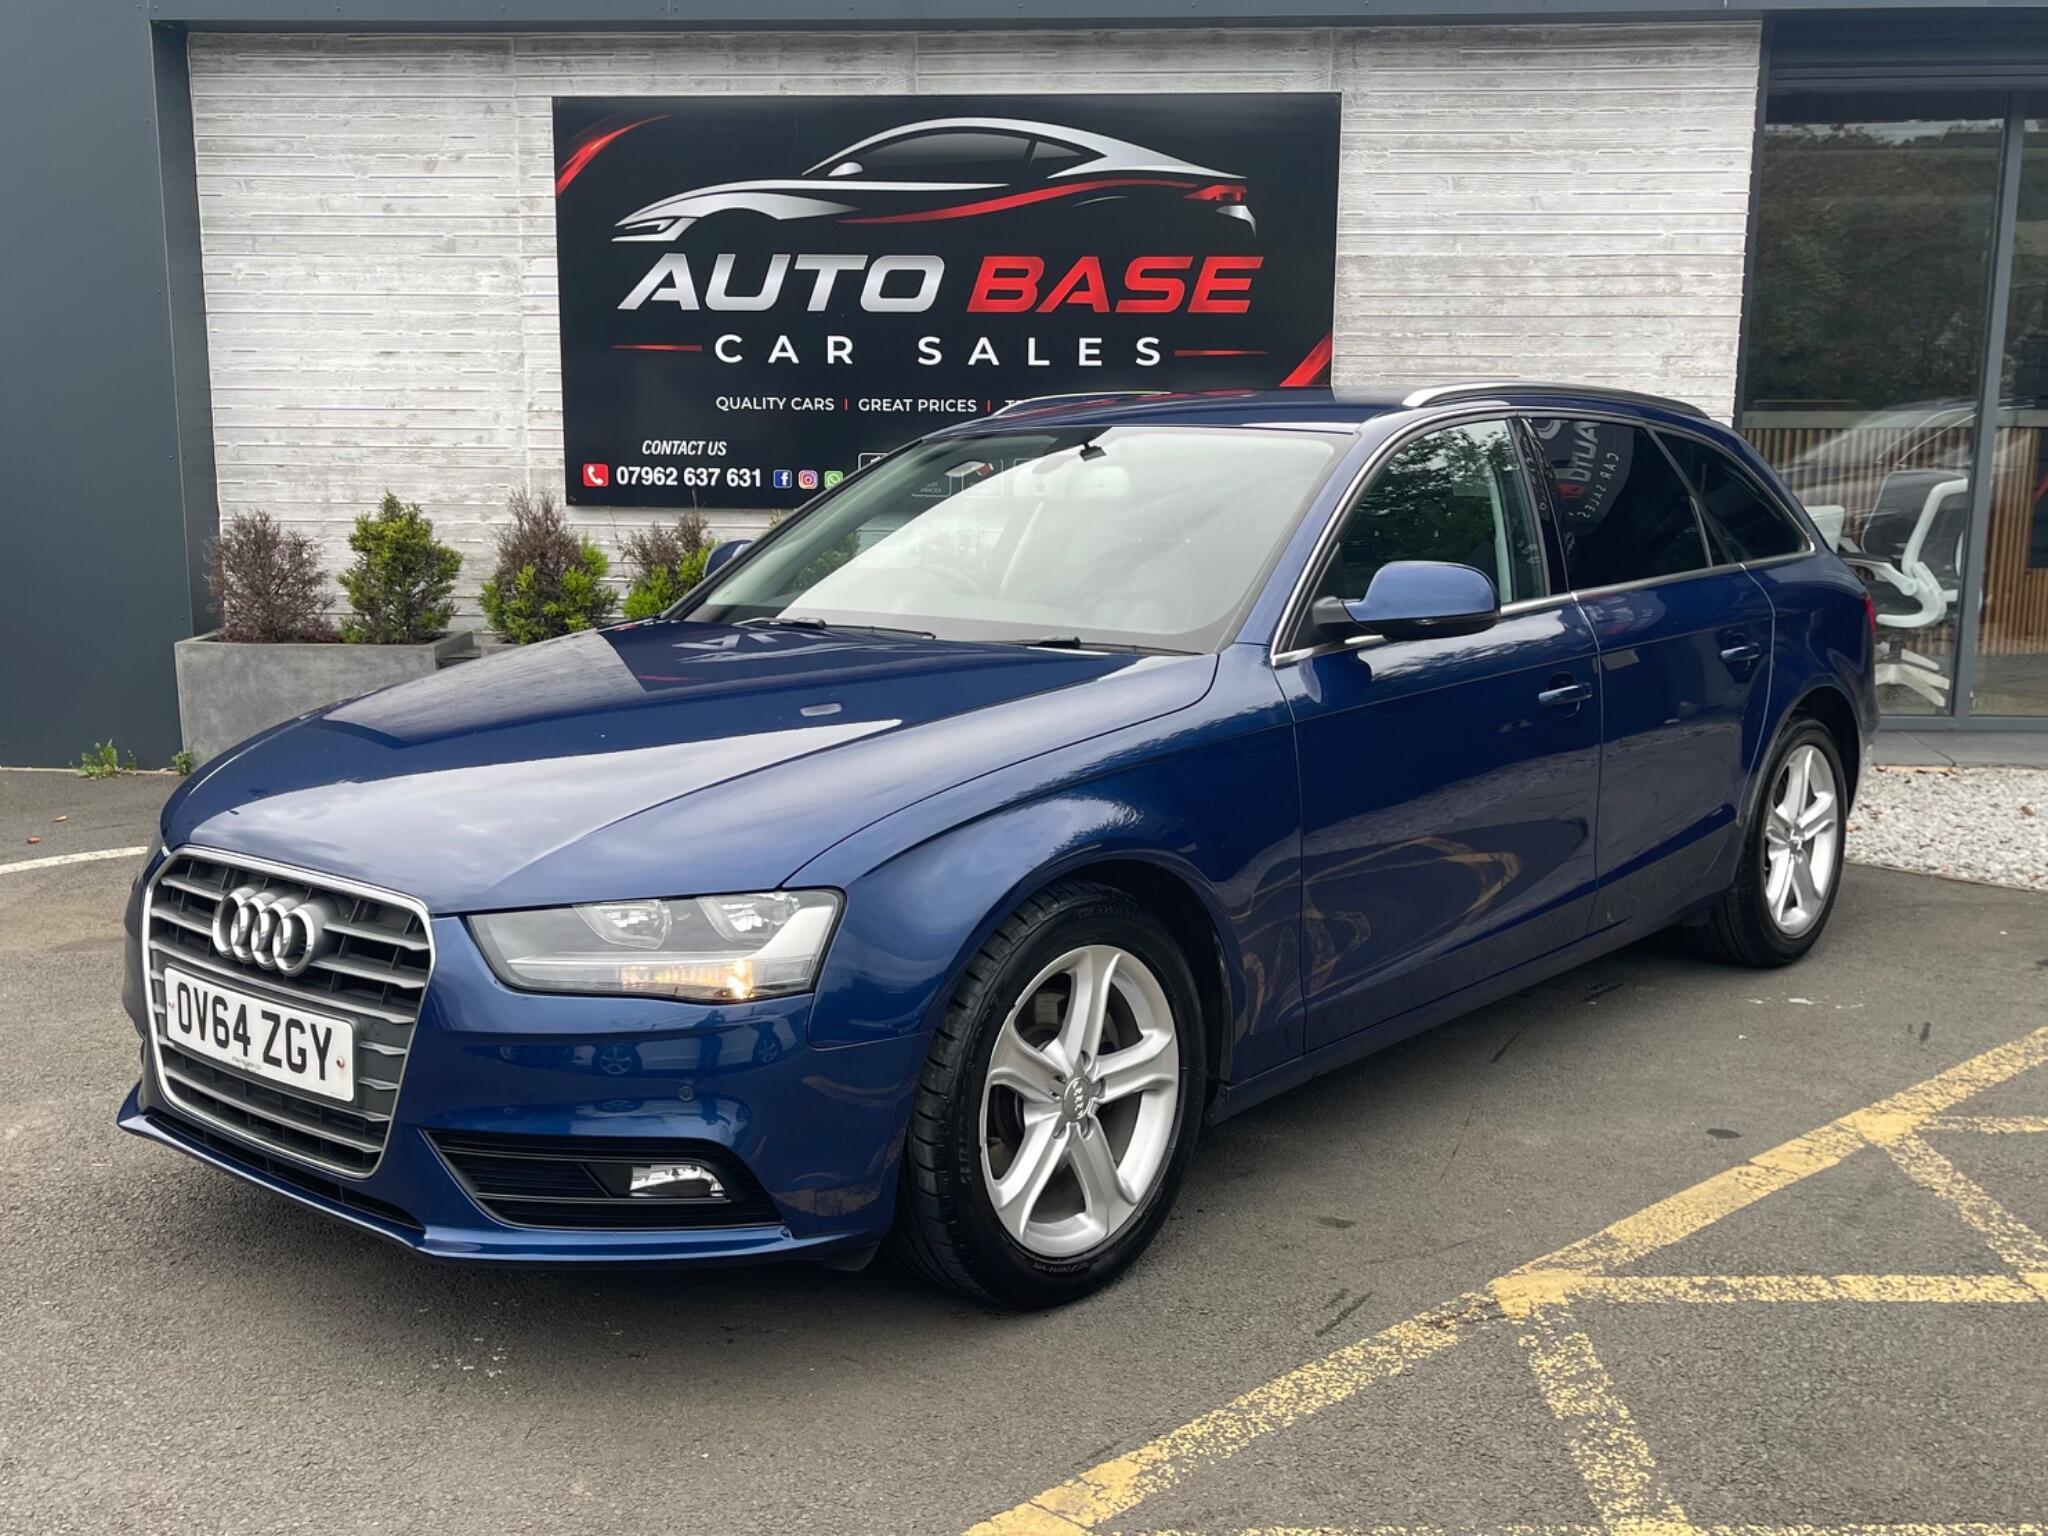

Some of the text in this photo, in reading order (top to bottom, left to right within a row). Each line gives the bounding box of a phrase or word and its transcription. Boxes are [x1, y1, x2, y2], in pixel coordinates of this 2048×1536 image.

[616, 252, 1264, 314] AUTO BASE
[714, 333, 1161, 367] CAR SALES
[715, 395, 978, 413] QUALITY CARS GREAT PRICES
[641, 439, 728, 457] CONTACT US
[615, 465, 761, 488] 07962 637 631
[177, 981, 332, 1081] OV64 ZGY
